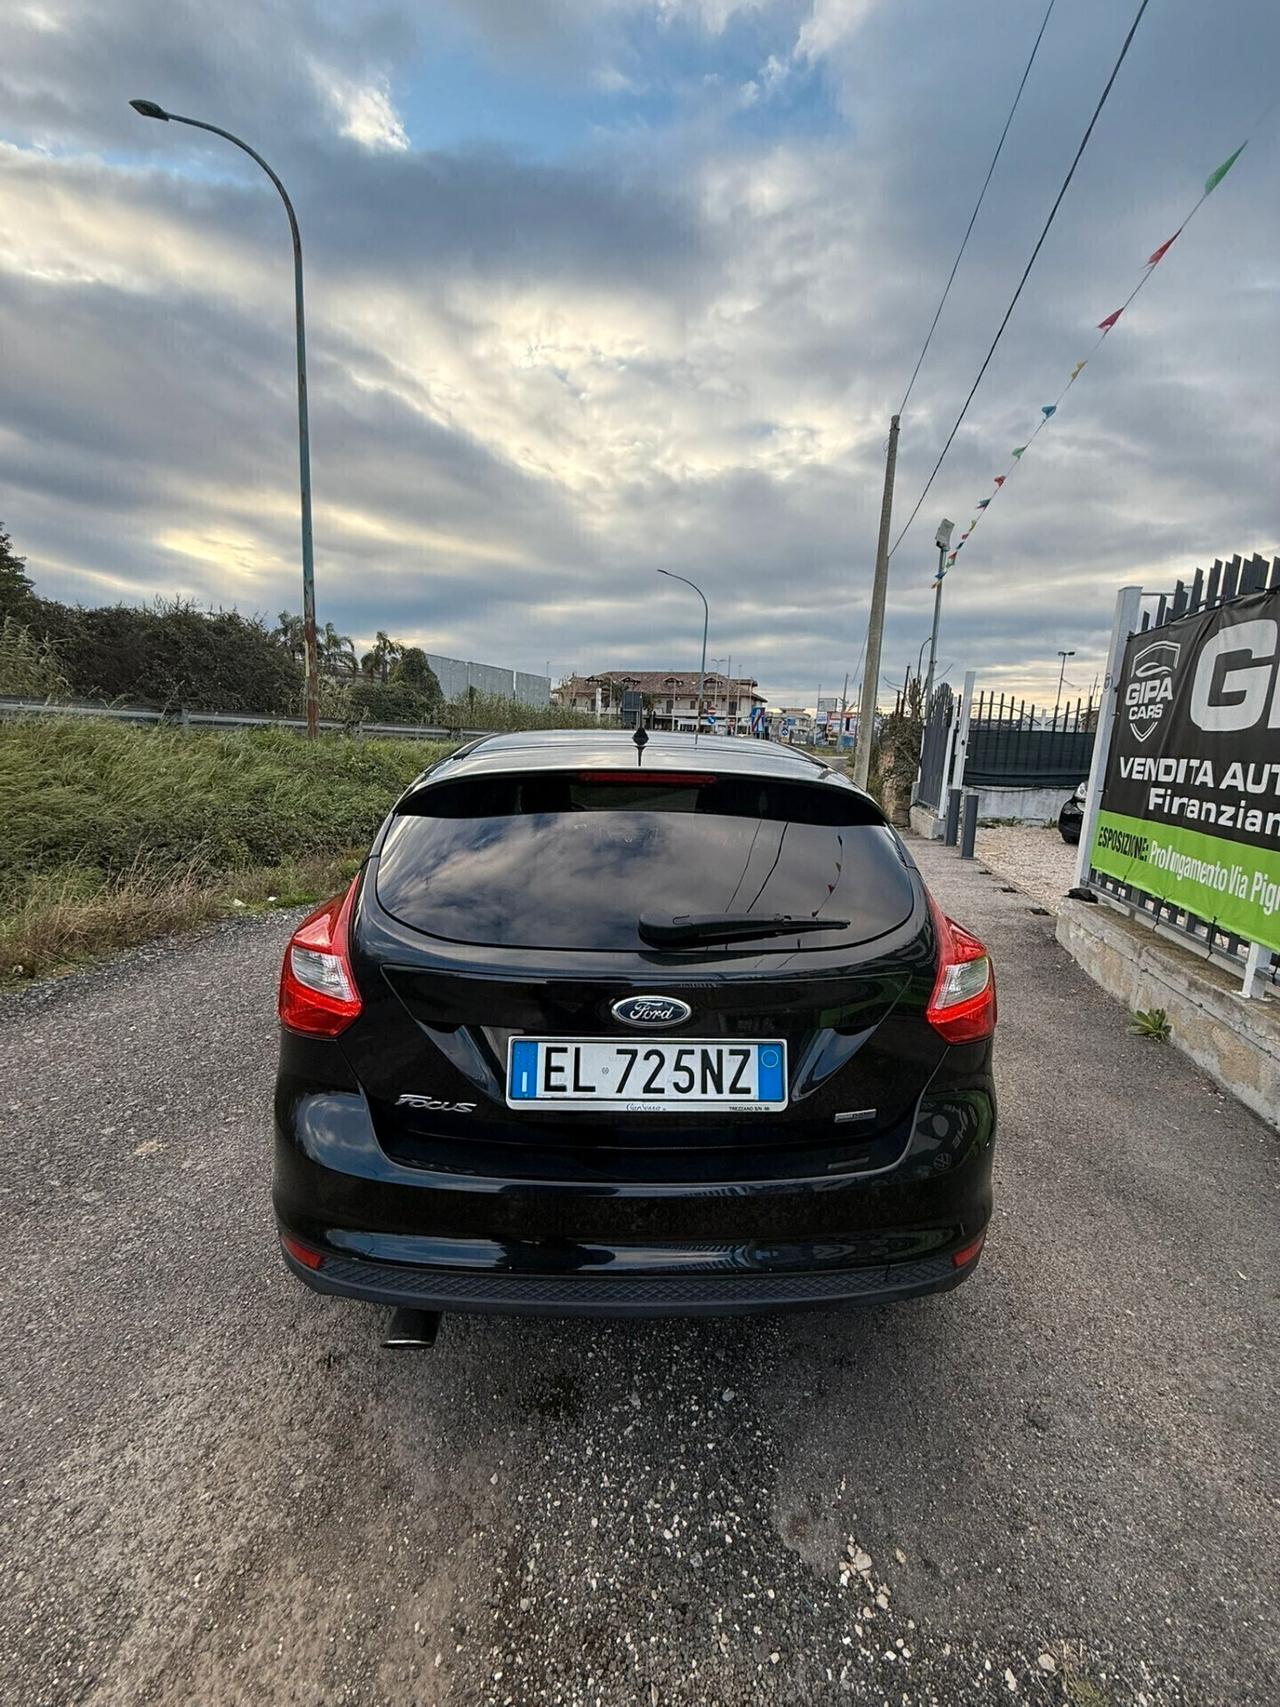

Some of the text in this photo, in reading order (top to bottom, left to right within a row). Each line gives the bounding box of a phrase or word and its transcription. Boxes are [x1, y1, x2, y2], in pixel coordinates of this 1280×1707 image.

[1125, 677, 1173, 706] GIPA
[1128, 703, 1164, 721] CARS
[1119, 756, 1214, 788] VENDITA
[1228, 864, 1249, 899] Via
[629, 1001, 674, 1020] Ford
[543, 1046, 752, 1095] EL 725NZ
